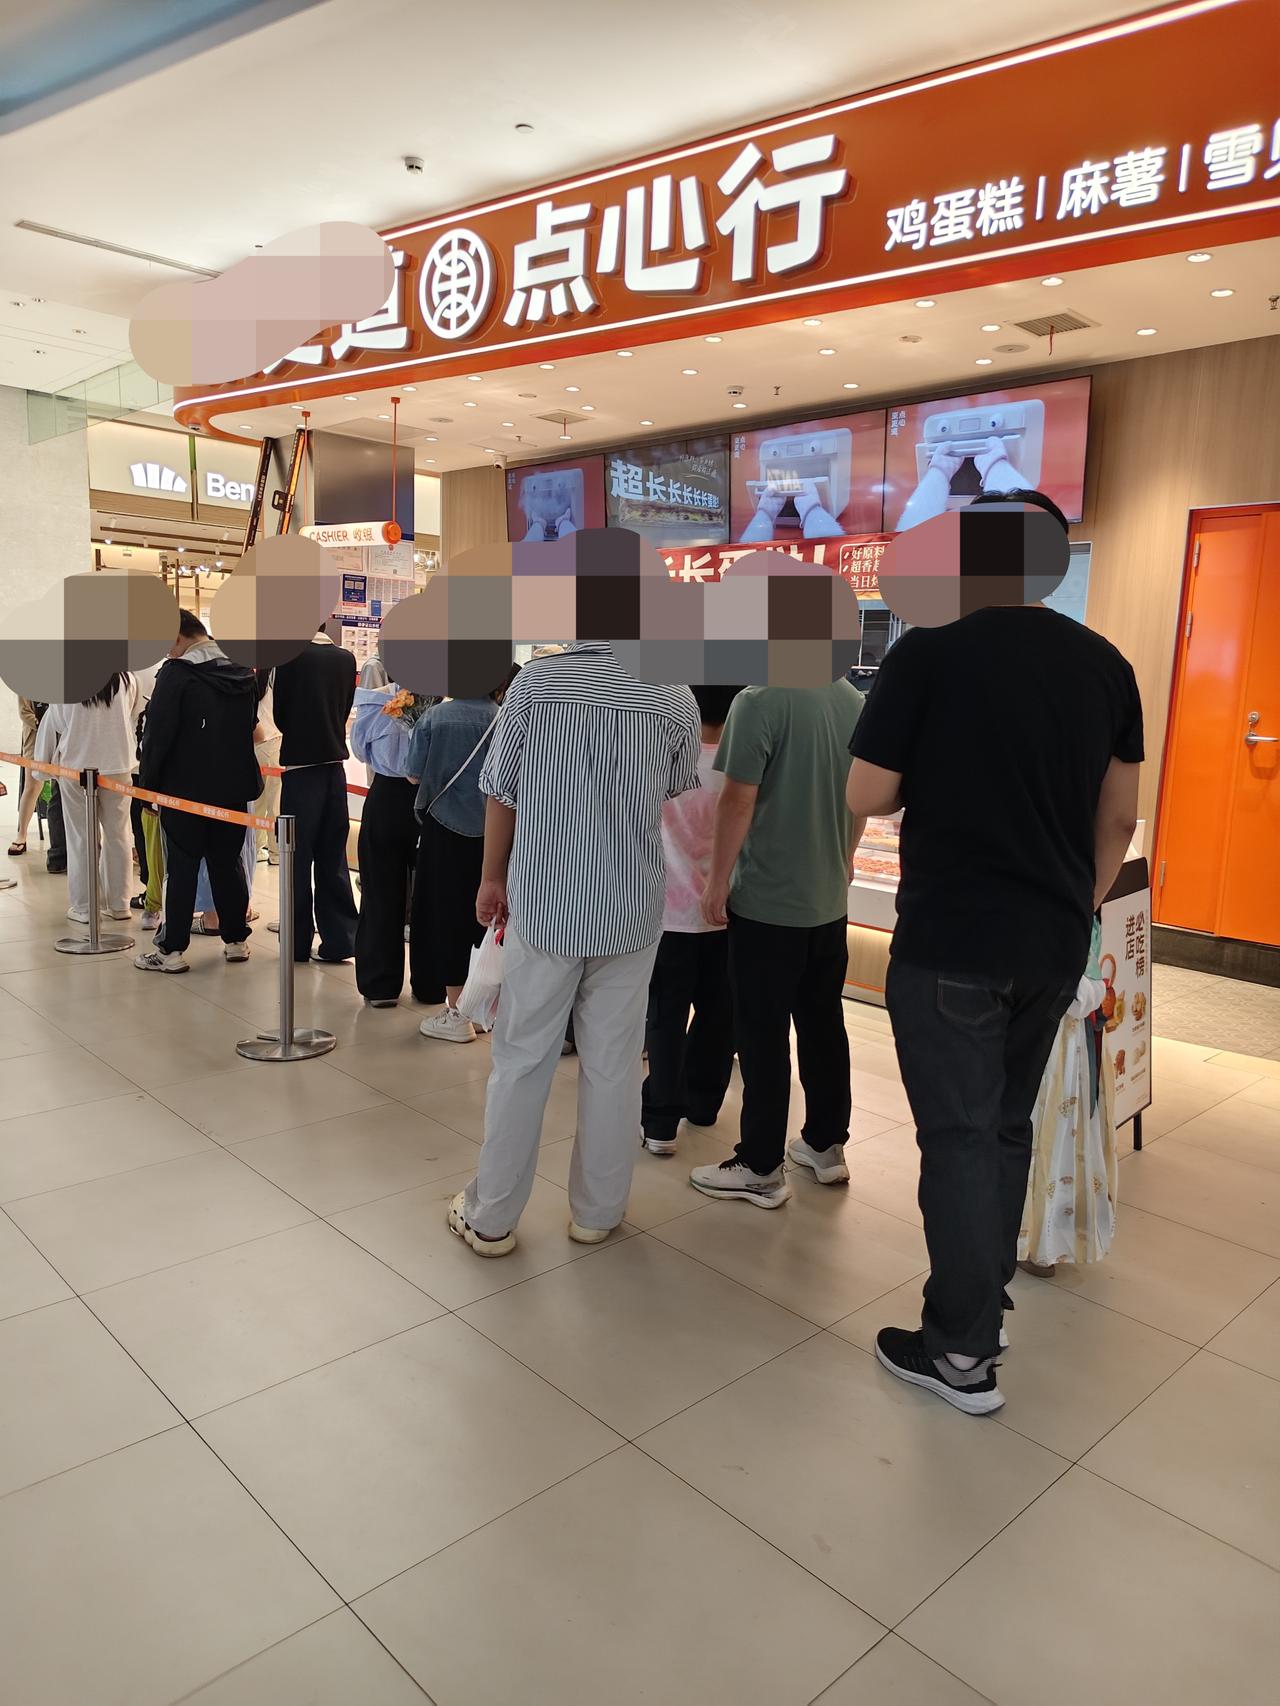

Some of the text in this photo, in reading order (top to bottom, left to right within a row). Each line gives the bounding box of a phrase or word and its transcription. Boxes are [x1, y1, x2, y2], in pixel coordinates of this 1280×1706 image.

[884, 175, 1025, 253] 鸡蛋糕
[1056, 146, 1168, 221] 麻薯
[503, 134, 848, 327] 点心行
[207, 472, 256, 502] Ben
[310, 528, 375, 543] CASHIER 收银
[1125, 915, 1136, 961] 进店
